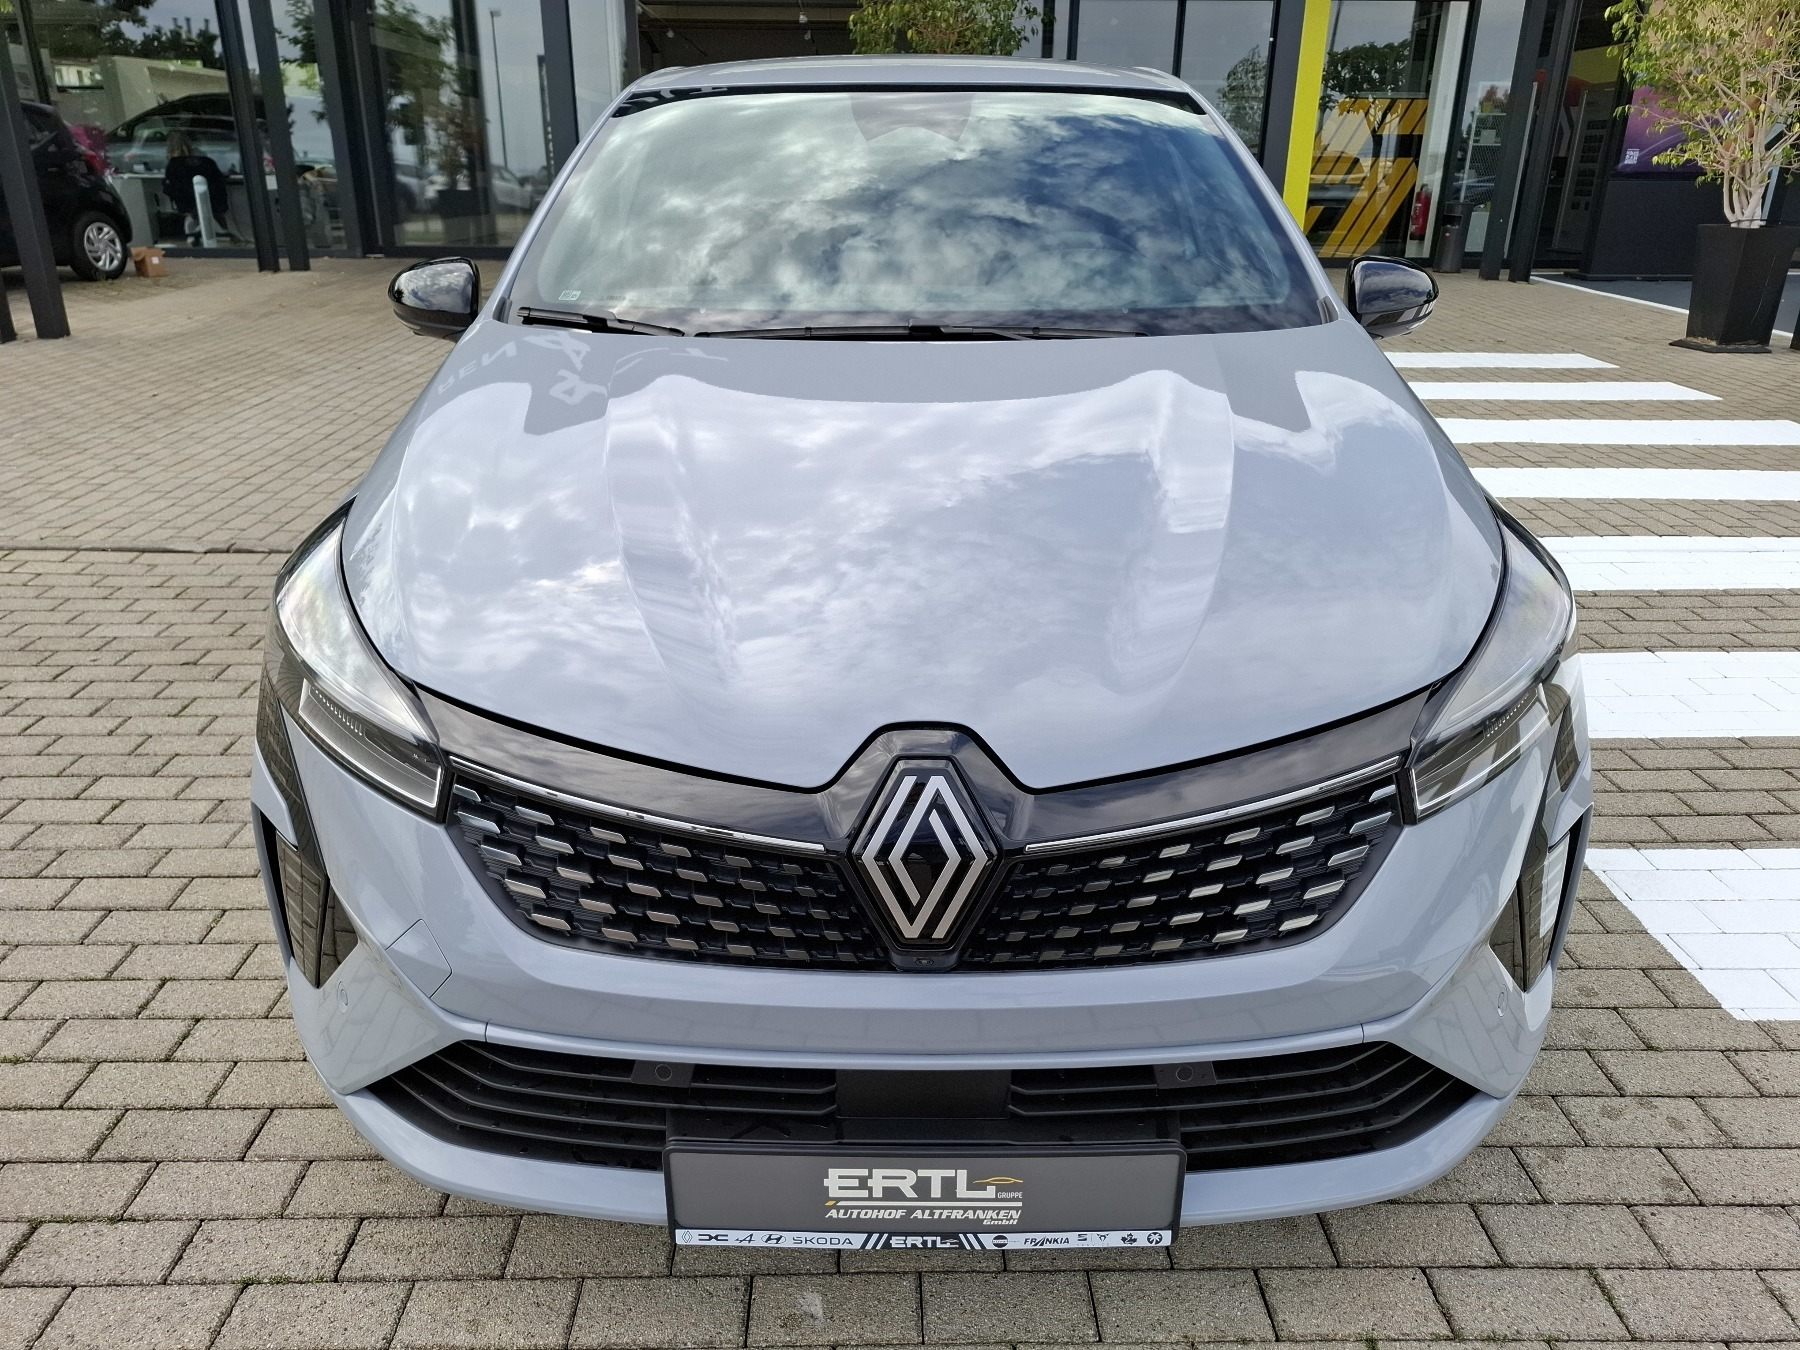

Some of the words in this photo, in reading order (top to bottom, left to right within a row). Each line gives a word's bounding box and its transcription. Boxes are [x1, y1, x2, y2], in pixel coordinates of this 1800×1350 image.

[823, 1168, 996, 1198] ERTL
[825, 1209, 907, 1219] AUTOHOF
[910, 1209, 1022, 1219] ALTFRANKEN
[889, 1236, 951, 1248] ERTL
[1024, 1236, 1070, 1247] FRANKIA
